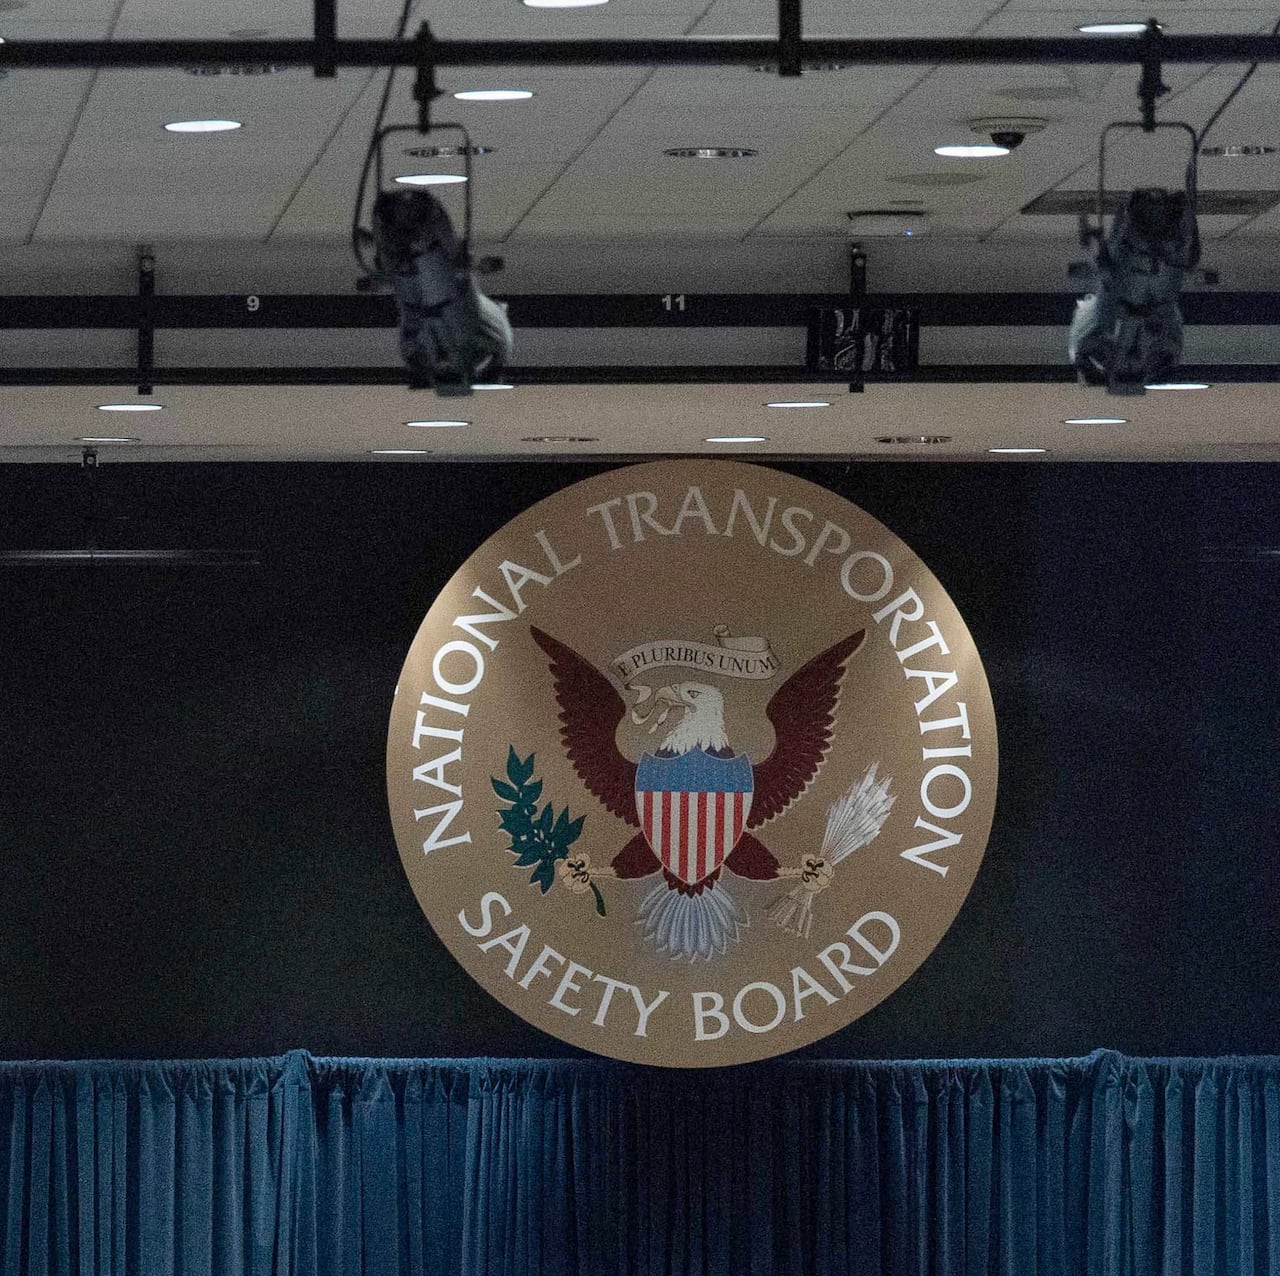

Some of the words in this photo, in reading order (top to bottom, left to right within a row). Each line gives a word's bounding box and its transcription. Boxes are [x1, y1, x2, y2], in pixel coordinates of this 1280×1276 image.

[246, 295, 260, 311] 9
[661, 294, 685, 311] 11
[631, 647, 715, 668] PLURIBUS
[718, 654, 776, 674] UNUM
[412, 528, 582, 856] NATIONAL
[586, 485, 973, 880] TRANSPORTATION
[458, 891, 670, 1037] SAFETY
[690, 910, 902, 1043] BOARD
